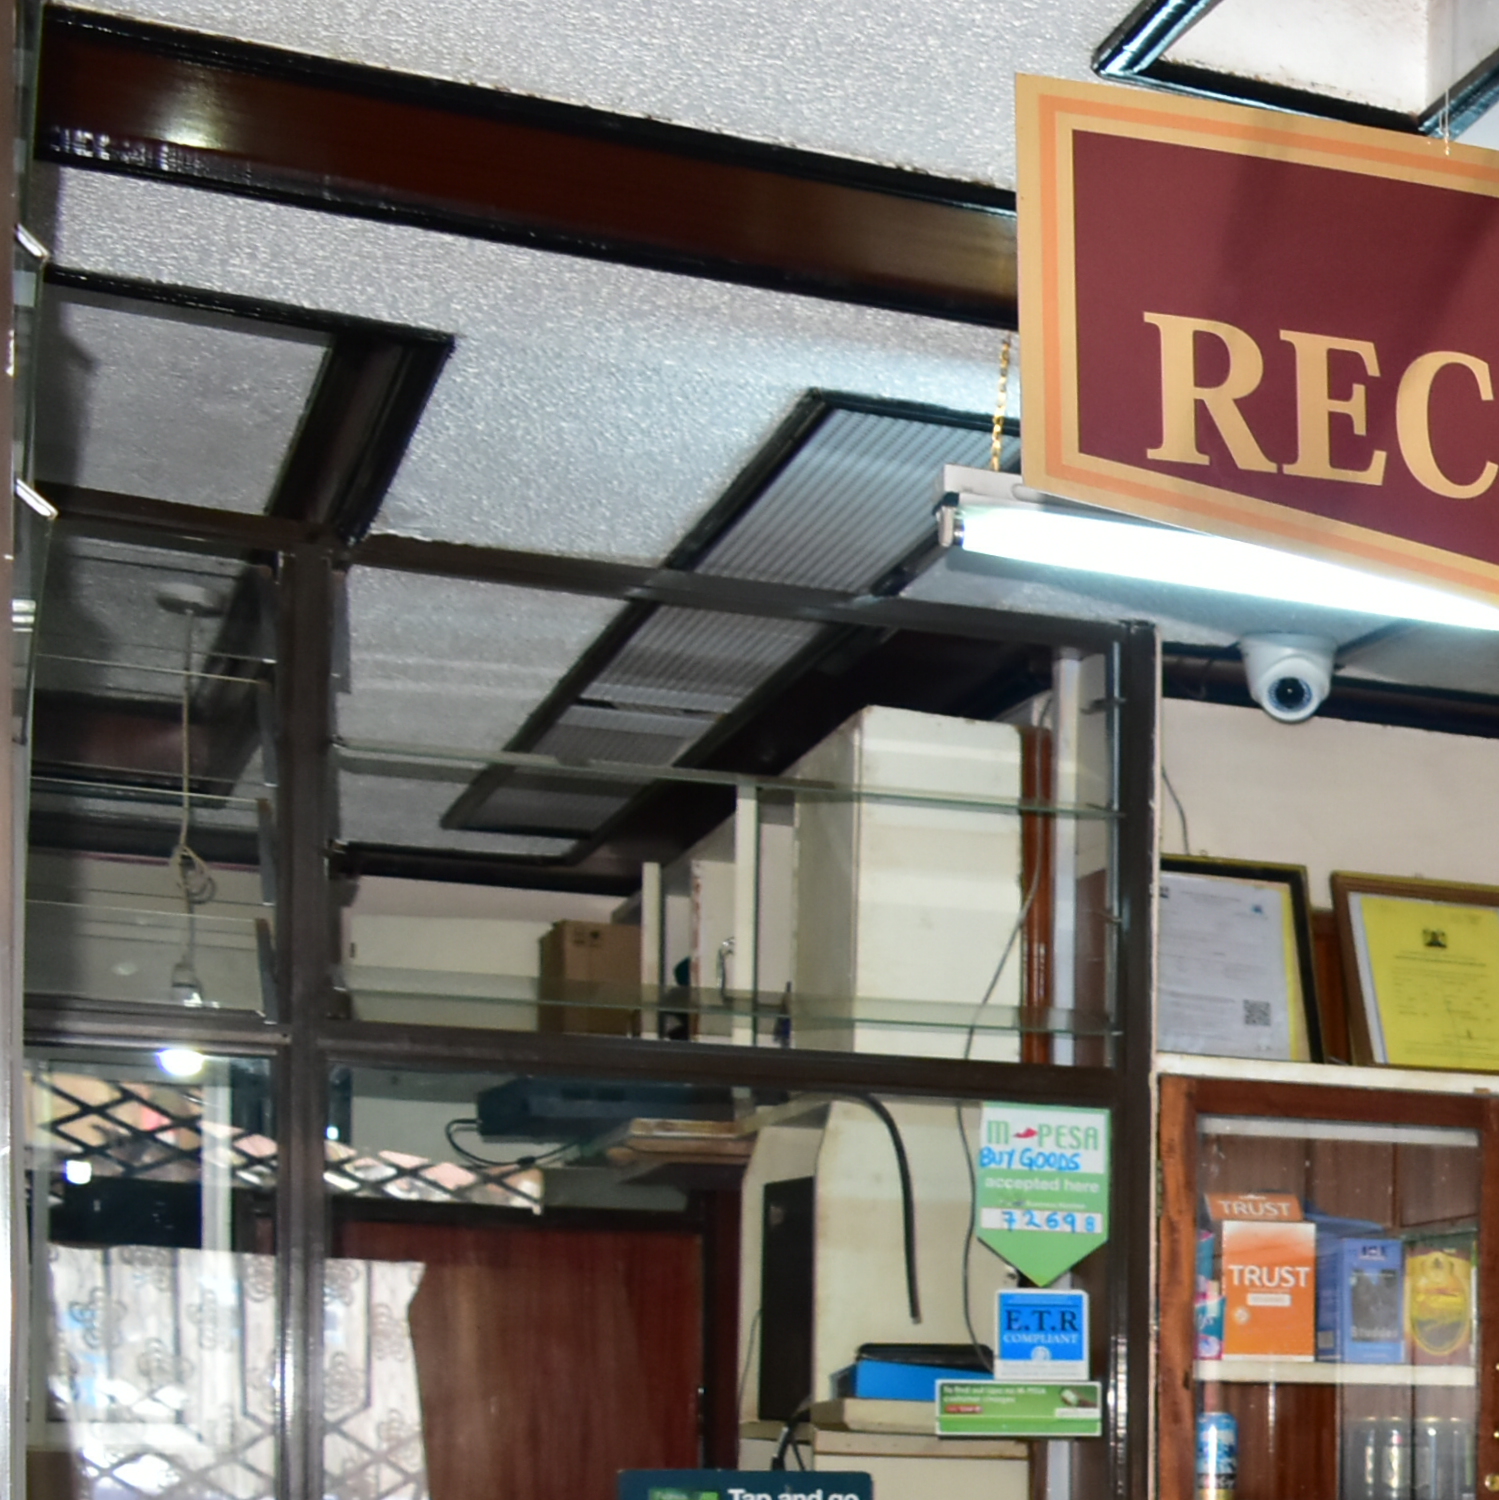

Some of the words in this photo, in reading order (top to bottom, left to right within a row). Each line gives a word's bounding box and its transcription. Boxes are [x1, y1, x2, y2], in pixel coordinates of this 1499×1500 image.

[980, 1147, 1015, 1169] BUY
[1020, 1147, 1081, 1171] GOODS
[985, 1177, 1060, 1192] accepted
[1063, 1178, 1099, 1193] here
[1218, 1200, 1291, 1217] TRUST
[1228, 1265, 1311, 1288] TRUST
[1005, 1310, 1078, 1331] E.T.R
[1003, 1334, 1078, 1343] COMPLIANT
